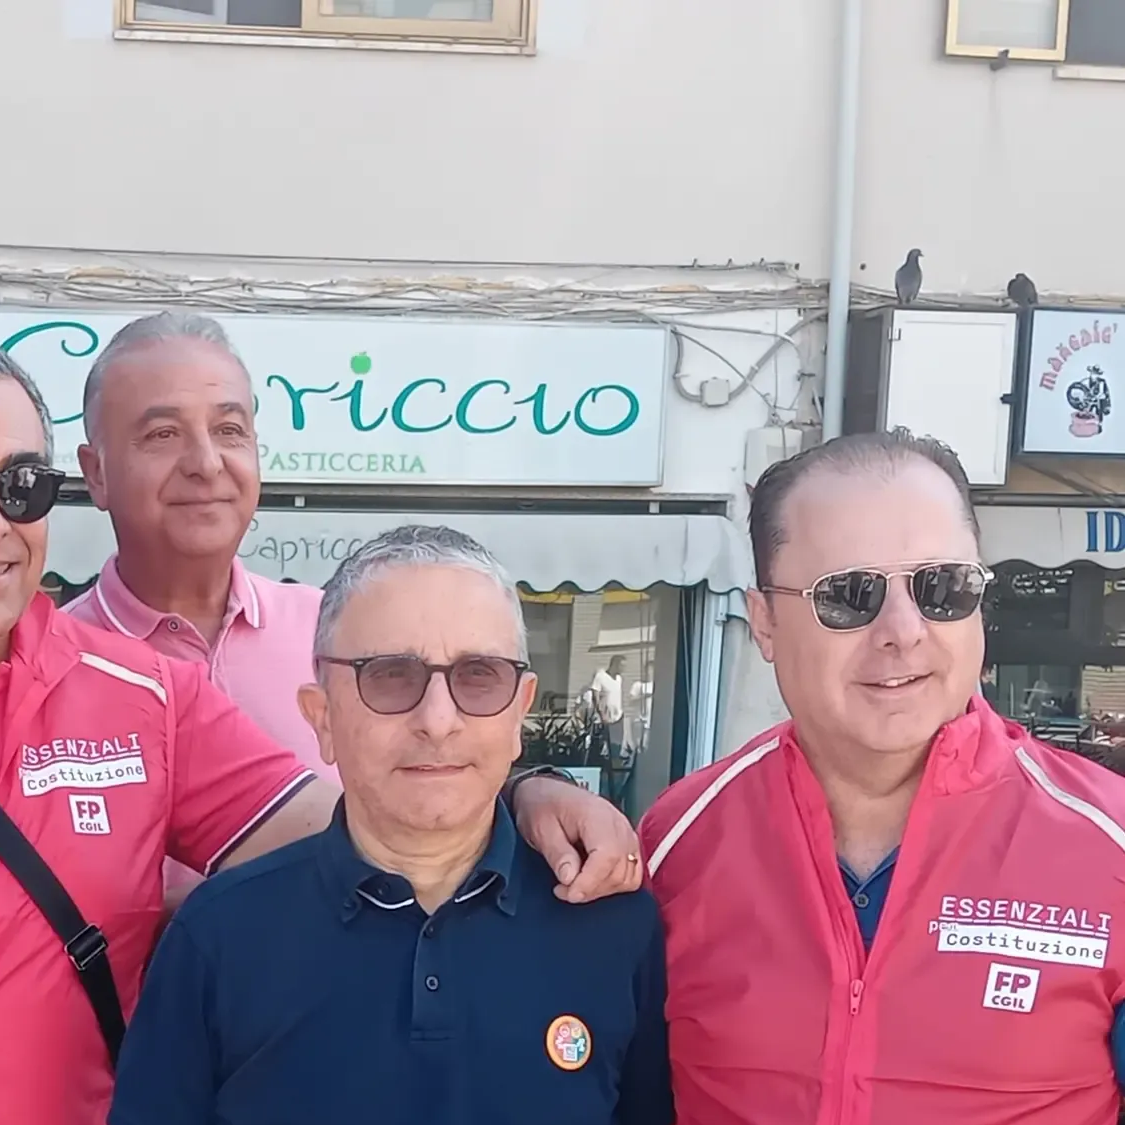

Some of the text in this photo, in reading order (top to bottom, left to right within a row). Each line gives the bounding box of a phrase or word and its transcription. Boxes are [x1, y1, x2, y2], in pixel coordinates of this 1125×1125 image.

[27, 764, 143, 791] Costituzione
[76, 801, 101, 820] FP
[79, 822, 104, 832] CGIL
[941, 896, 1111, 933] ESSENZIALI
[946, 931, 1103, 960] Costituzione
[994, 971, 1031, 994] FP
[991, 995, 1026, 1009] CGIL
